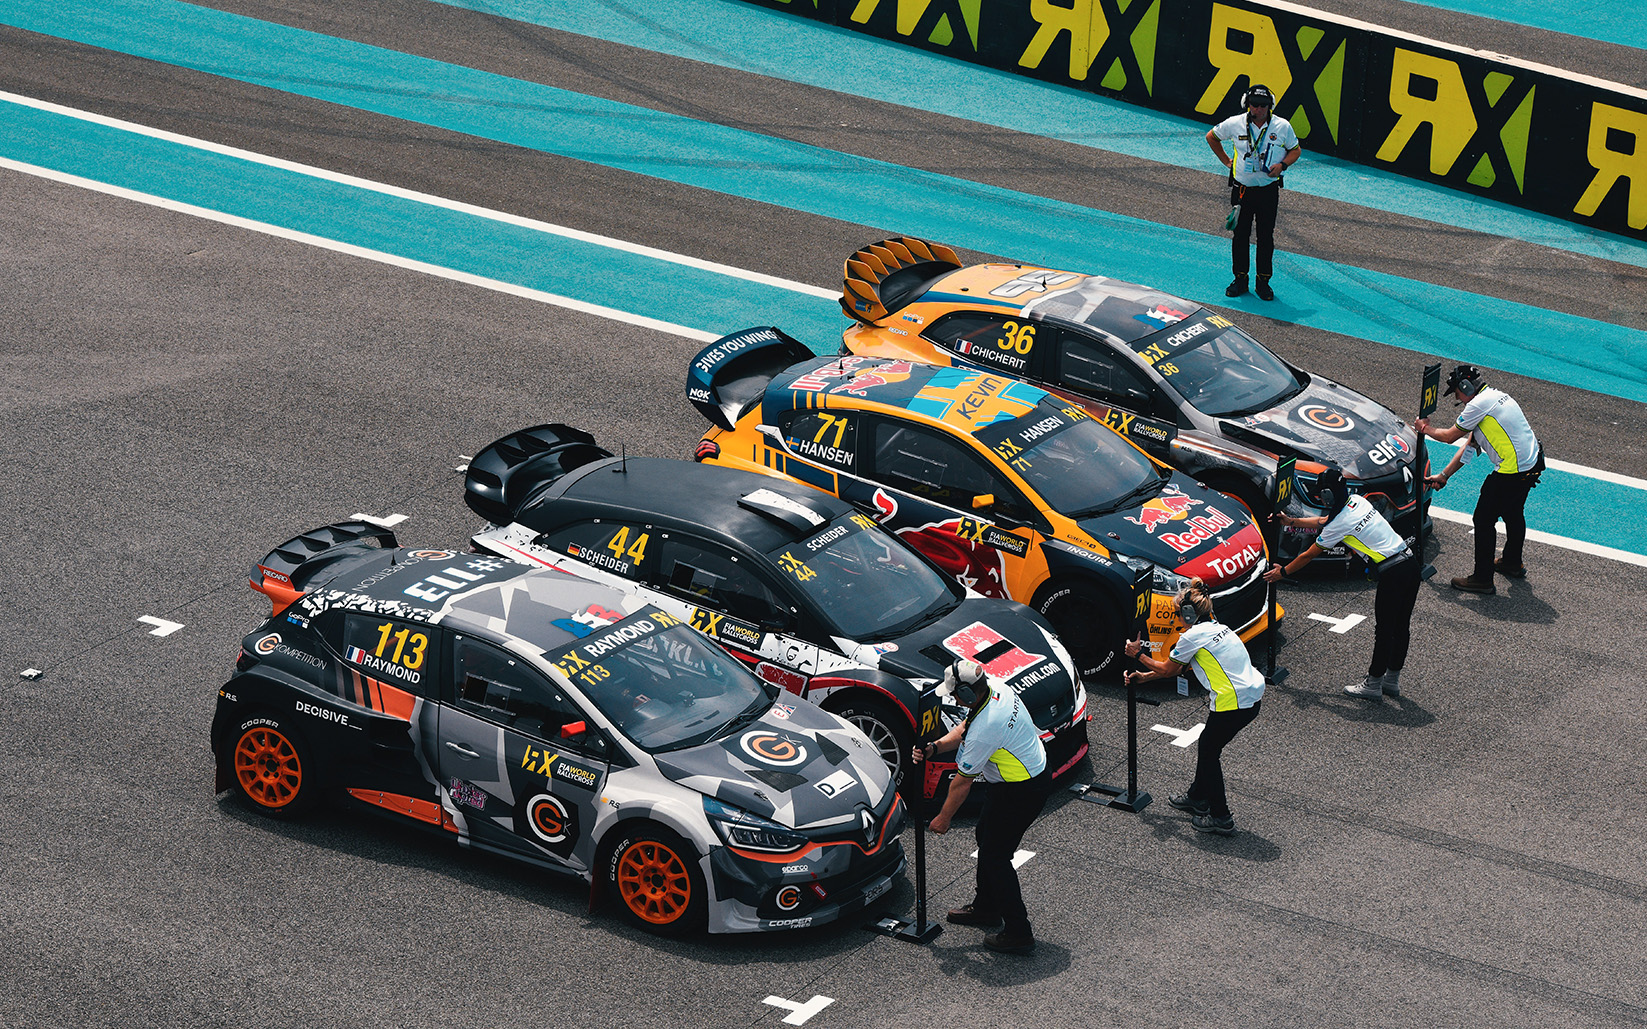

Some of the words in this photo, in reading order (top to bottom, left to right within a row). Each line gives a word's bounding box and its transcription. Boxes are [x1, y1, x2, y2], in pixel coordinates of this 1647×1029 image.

[998, 320, 1036, 355] 36
[1167, 322, 1209, 347] CHICHERIT
[695, 348, 725, 373] GIVES
[718, 337, 746, 354] YOU
[741, 330, 780, 345] WING
[971, 345, 1026, 370] CHICHERIT
[1158, 362, 1180, 377] 36
[690, 388, 710, 400] NGK
[813, 412, 848, 448] 71
[1019, 415, 1065, 443] HANSEN
[1133, 427, 1166, 442] RALLYCROSS
[800, 440, 854, 466] HANSEN
[1011, 458, 1032, 472] 71
[1368, 440, 1398, 466] elf
[608, 526, 650, 566] 44
[806, 525, 849, 551] SCHEIDER
[988, 535, 1023, 553] RALLYCROSS
[579, 547, 630, 574] SCHEIDER
[1066, 545, 1113, 567] INQUIRE
[1206, 544, 1261, 579] TOTAL
[263, 569, 289, 583] RECARO
[795, 564, 818, 582] 44
[1041, 588, 1071, 614] COOPER
[288, 611, 310, 624] GoPro
[376, 622, 429, 670] 113
[584, 620, 656, 658] RAYMOND
[722, 628, 759, 645] RALLYCROSS
[1140, 640, 1164, 648] OOPER
[363, 654, 421, 684] RAYMOND
[580, 664, 611, 685] 113
[1083, 650, 1115, 676] COOPER
[240, 718, 279, 730] COOPER
[557, 768, 594, 786] RALLYCROSS
[609, 838, 630, 882] COOPER
[781, 864, 808, 874] sparco
[769, 917, 813, 927] COOPER
